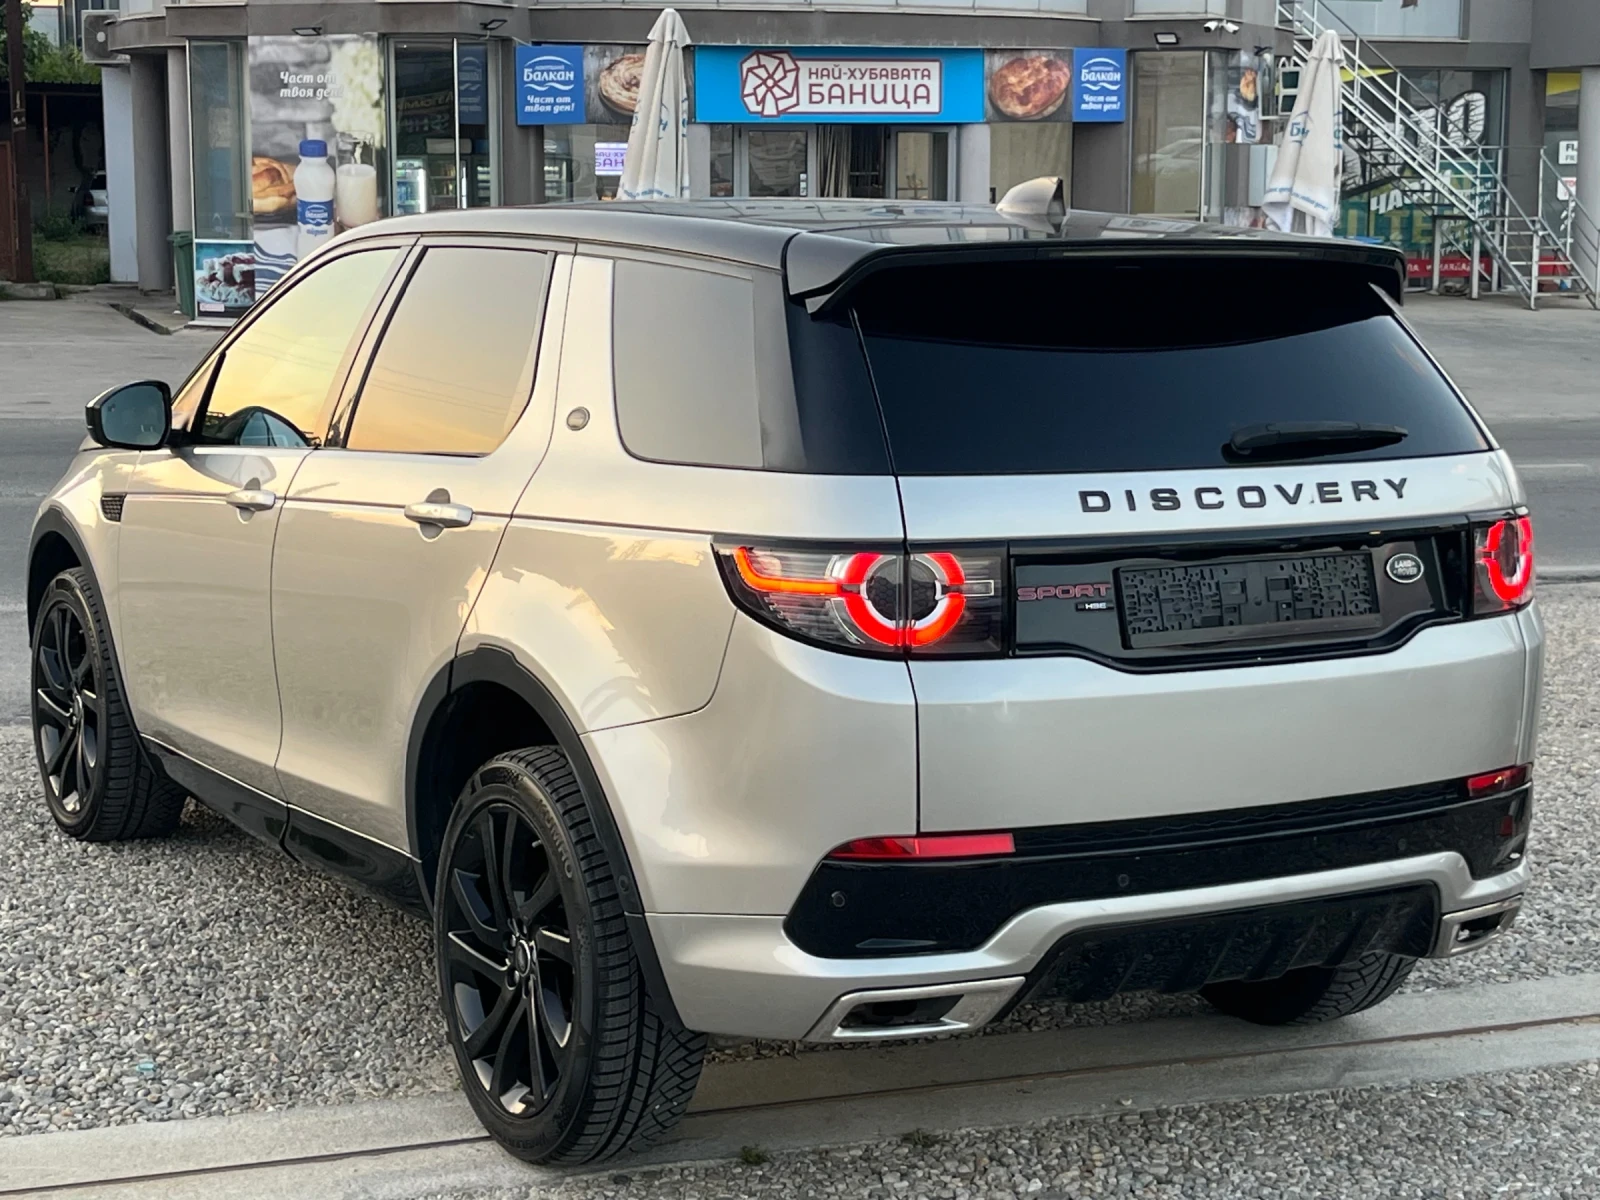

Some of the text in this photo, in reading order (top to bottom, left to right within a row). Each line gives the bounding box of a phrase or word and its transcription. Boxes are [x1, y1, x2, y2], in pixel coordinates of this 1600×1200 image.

[280, 71, 337, 84] Част от
[523, 68, 574, 81] Балкан
[808, 64, 931, 80] НАЙ-ХУБАВАТА
[1081, 69, 1121, 81] Балкан
[280, 86, 314, 98] твоя
[808, 83, 931, 109] БАНИЦА
[527, 95, 572, 104] Част от
[524, 104, 552, 112] твоя
[1078, 478, 1408, 513] DISCOVERY
[1017, 583, 1111, 601] SPORT
